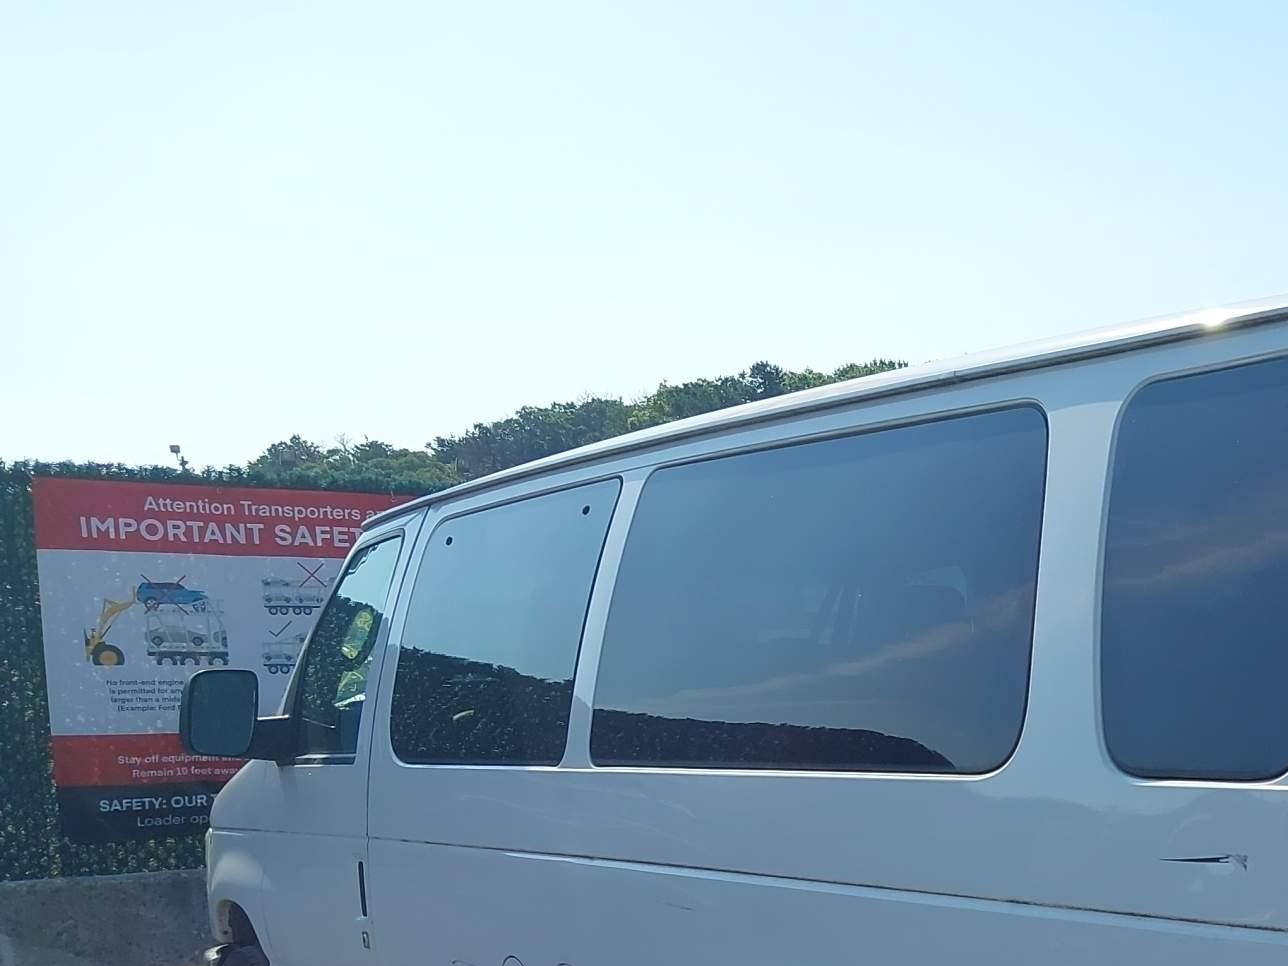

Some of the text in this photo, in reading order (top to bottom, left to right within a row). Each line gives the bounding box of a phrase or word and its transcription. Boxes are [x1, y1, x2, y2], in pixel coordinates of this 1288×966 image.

[144, 496, 234, 515] Attention
[240, 501, 361, 520] Transporters
[80, 516, 264, 544] IMPORTANT
[118, 755, 140, 765] Stay
[144, 754, 159, 763] off
[132, 768, 173, 778] Remain
[191, 766, 212, 775] feet
[99, 797, 167, 812] SAFETY:
[171, 794, 208, 808] OUR
[137, 814, 186, 827] Loader
